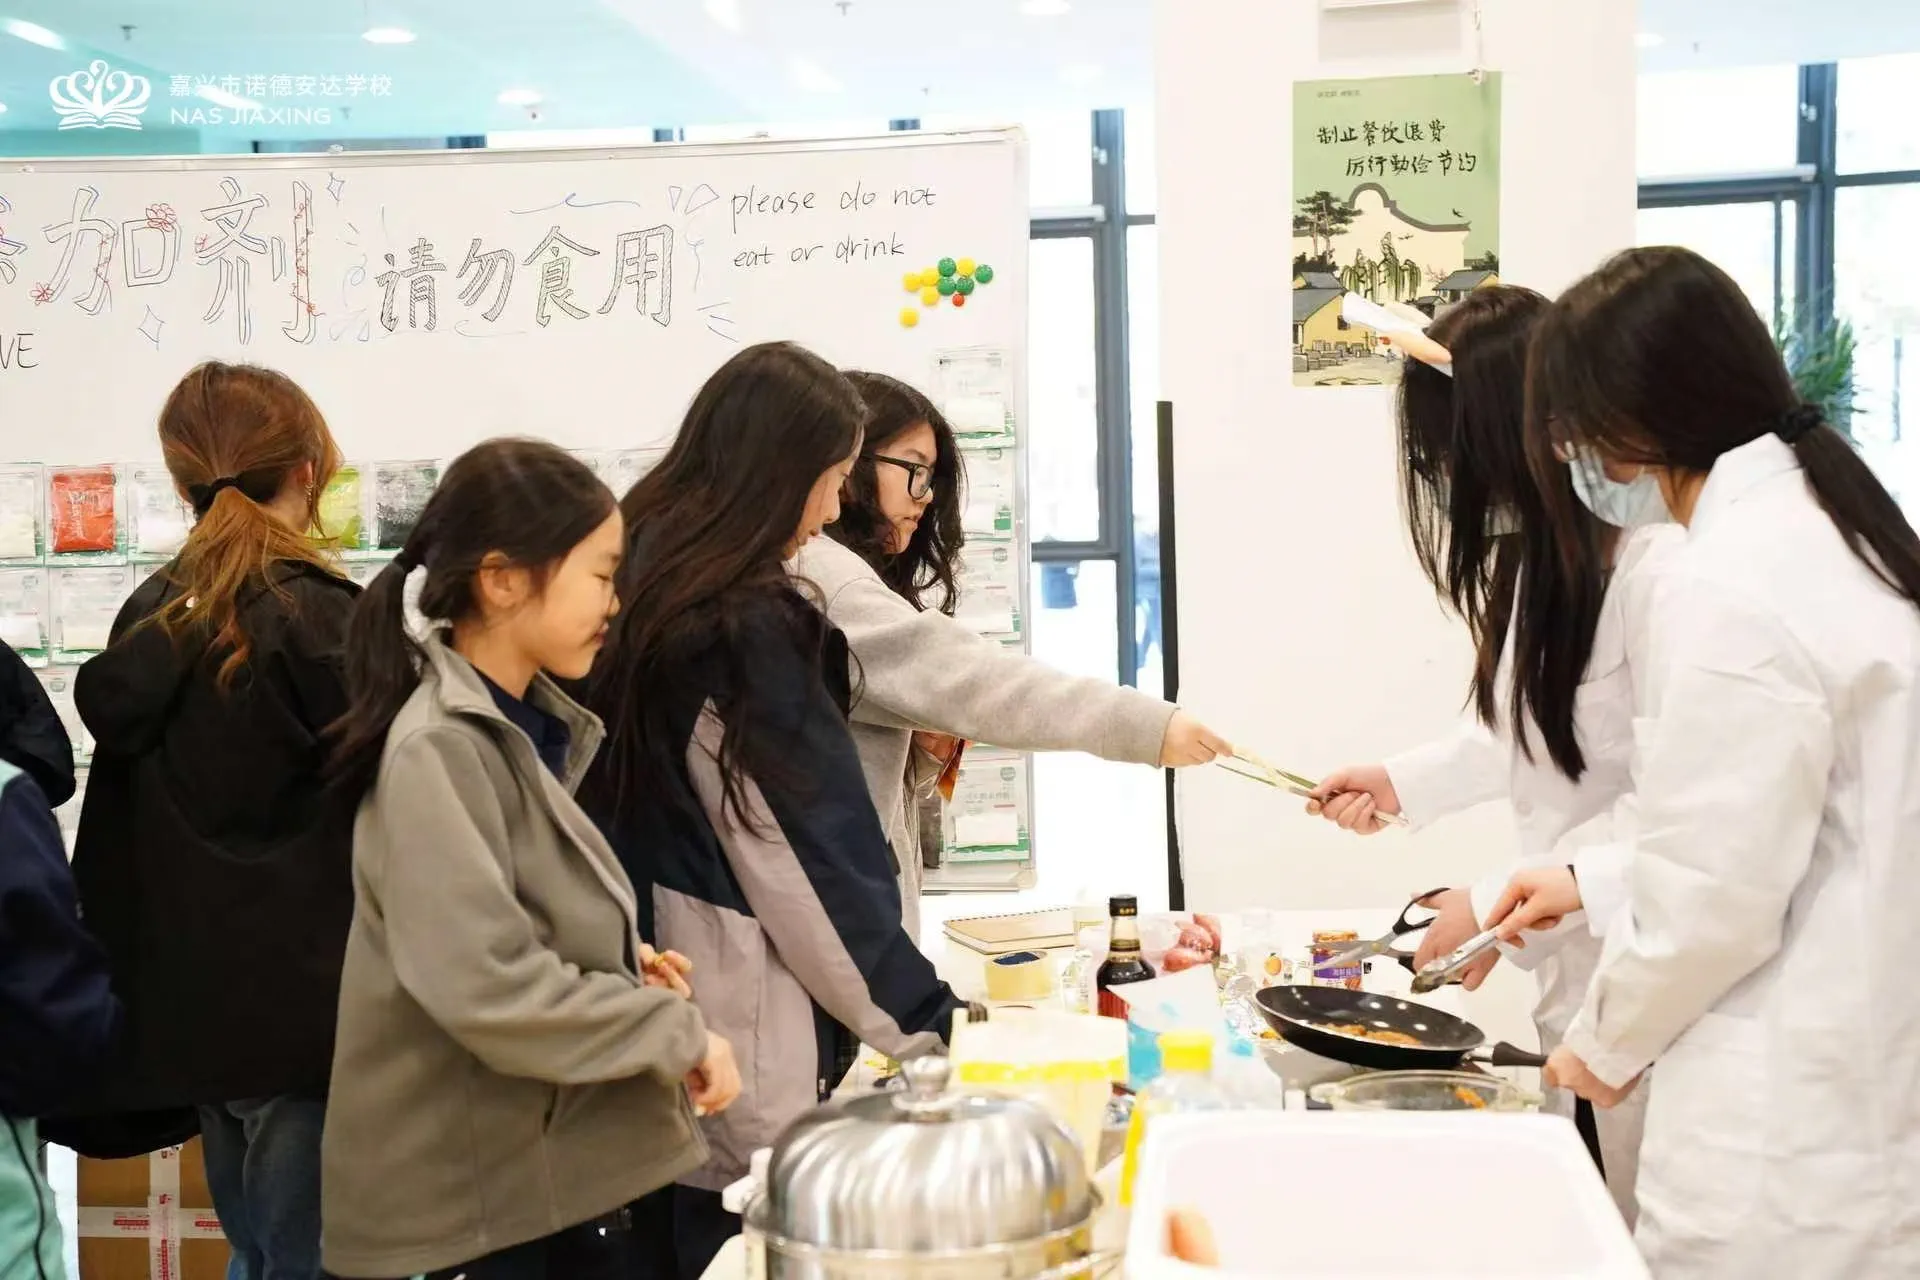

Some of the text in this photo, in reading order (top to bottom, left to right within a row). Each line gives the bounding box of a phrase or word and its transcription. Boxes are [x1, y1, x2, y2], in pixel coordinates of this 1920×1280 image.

[1317, 119, 1446, 146] 制止餐饮浪费
[1345, 150, 1477, 177] 厉行勤俭节约
[731, 180, 937, 234] please do not
[734, 232, 905, 267] eat or drink
[374, 224, 675, 332] 请勿食用
